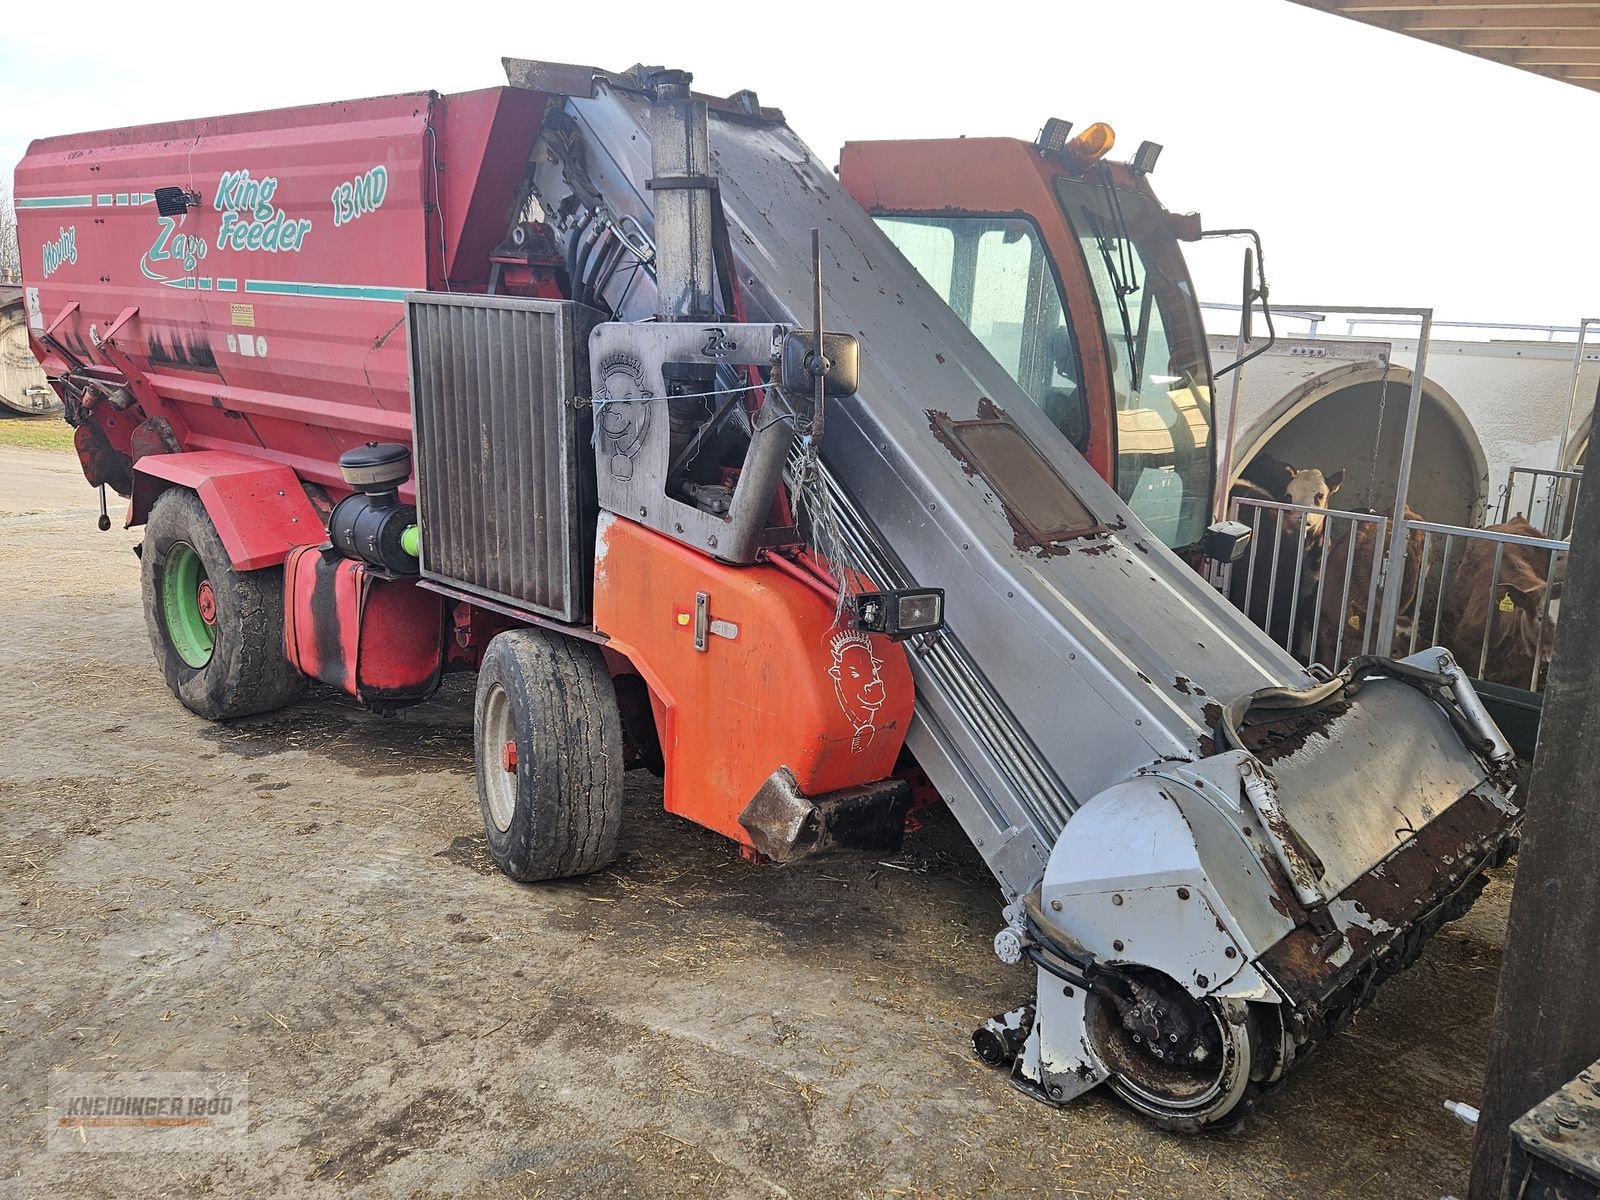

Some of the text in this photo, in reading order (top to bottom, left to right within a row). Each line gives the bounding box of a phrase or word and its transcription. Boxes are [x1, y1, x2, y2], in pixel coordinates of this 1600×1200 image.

[214, 169, 277, 222] King
[331, 165, 387, 227] 13MD
[43, 225, 77, 278] Moving
[149, 216, 207, 271] Zago
[217, 208, 312, 253] Feeder
